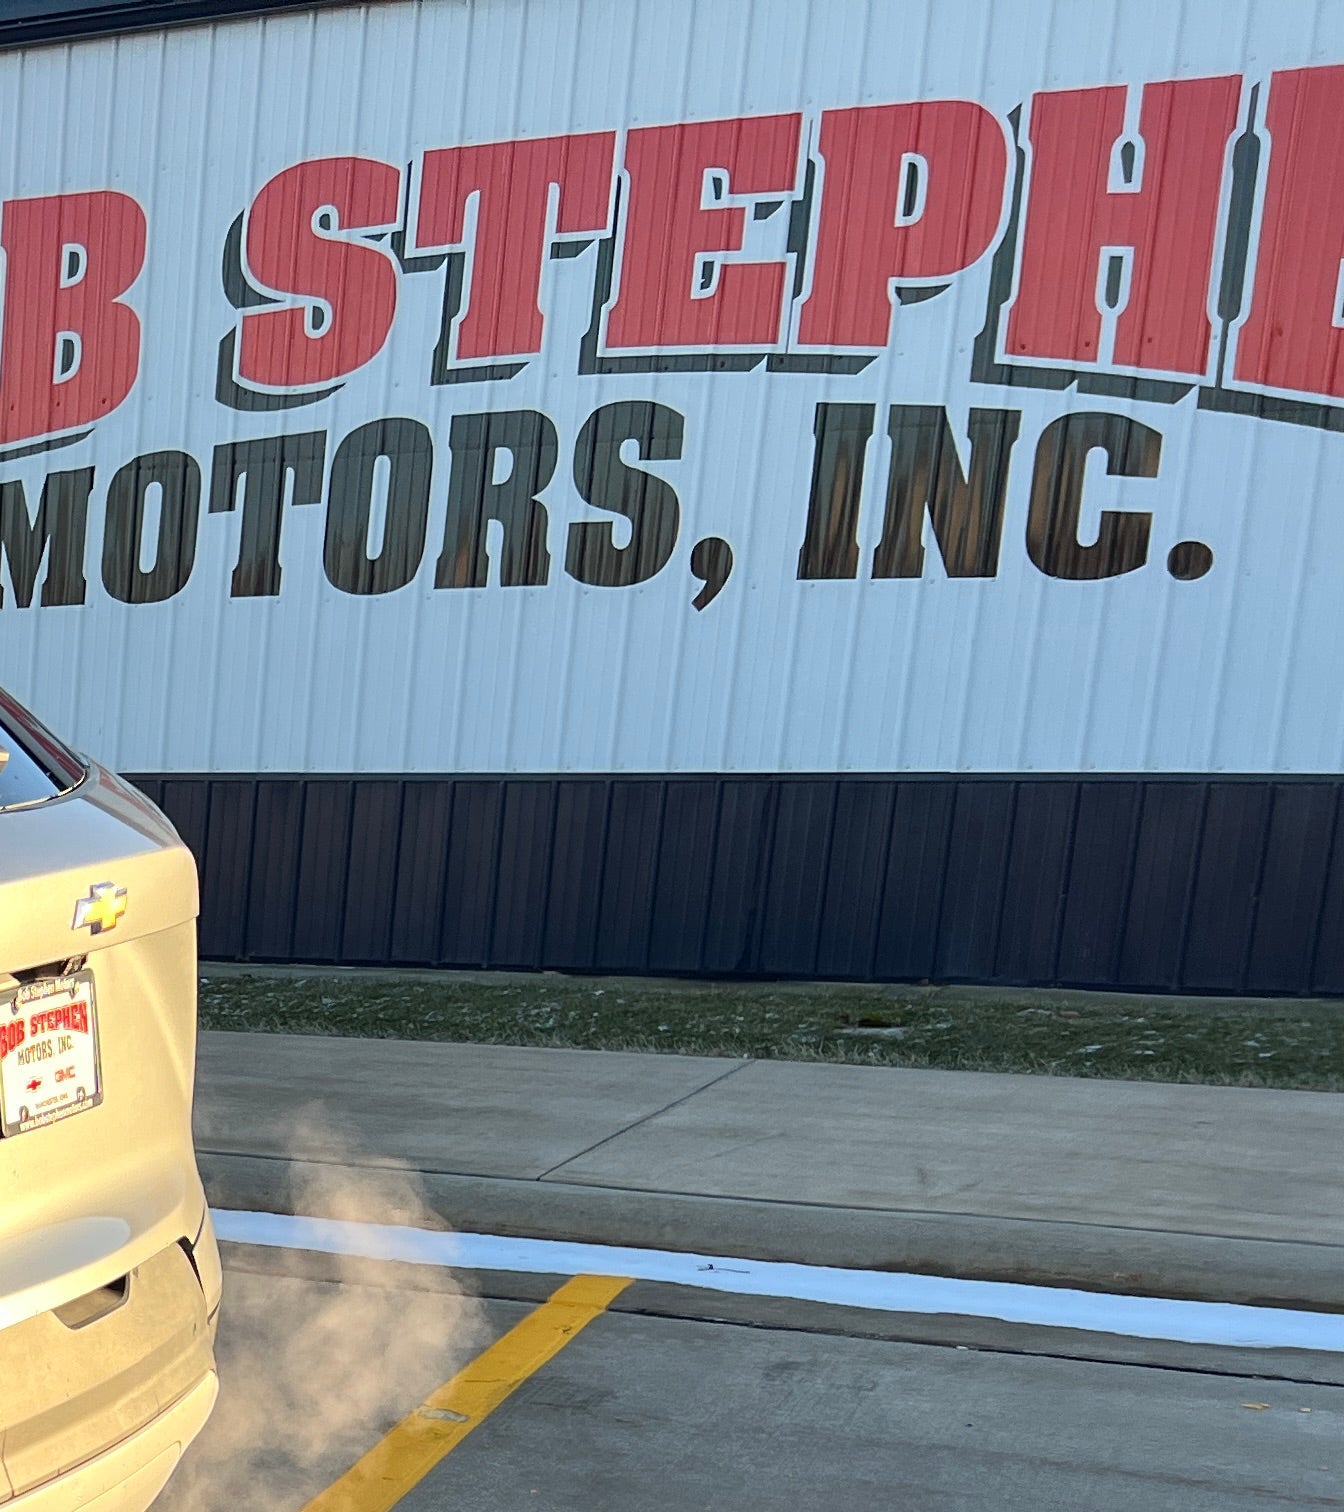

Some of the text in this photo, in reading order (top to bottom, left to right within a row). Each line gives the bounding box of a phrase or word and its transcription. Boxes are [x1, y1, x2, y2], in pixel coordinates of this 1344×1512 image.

[798, 402, 1213, 581] INC.
[30, 1000, 89, 1037] STEPHEN
[55, 1065, 76, 1083] GMC
